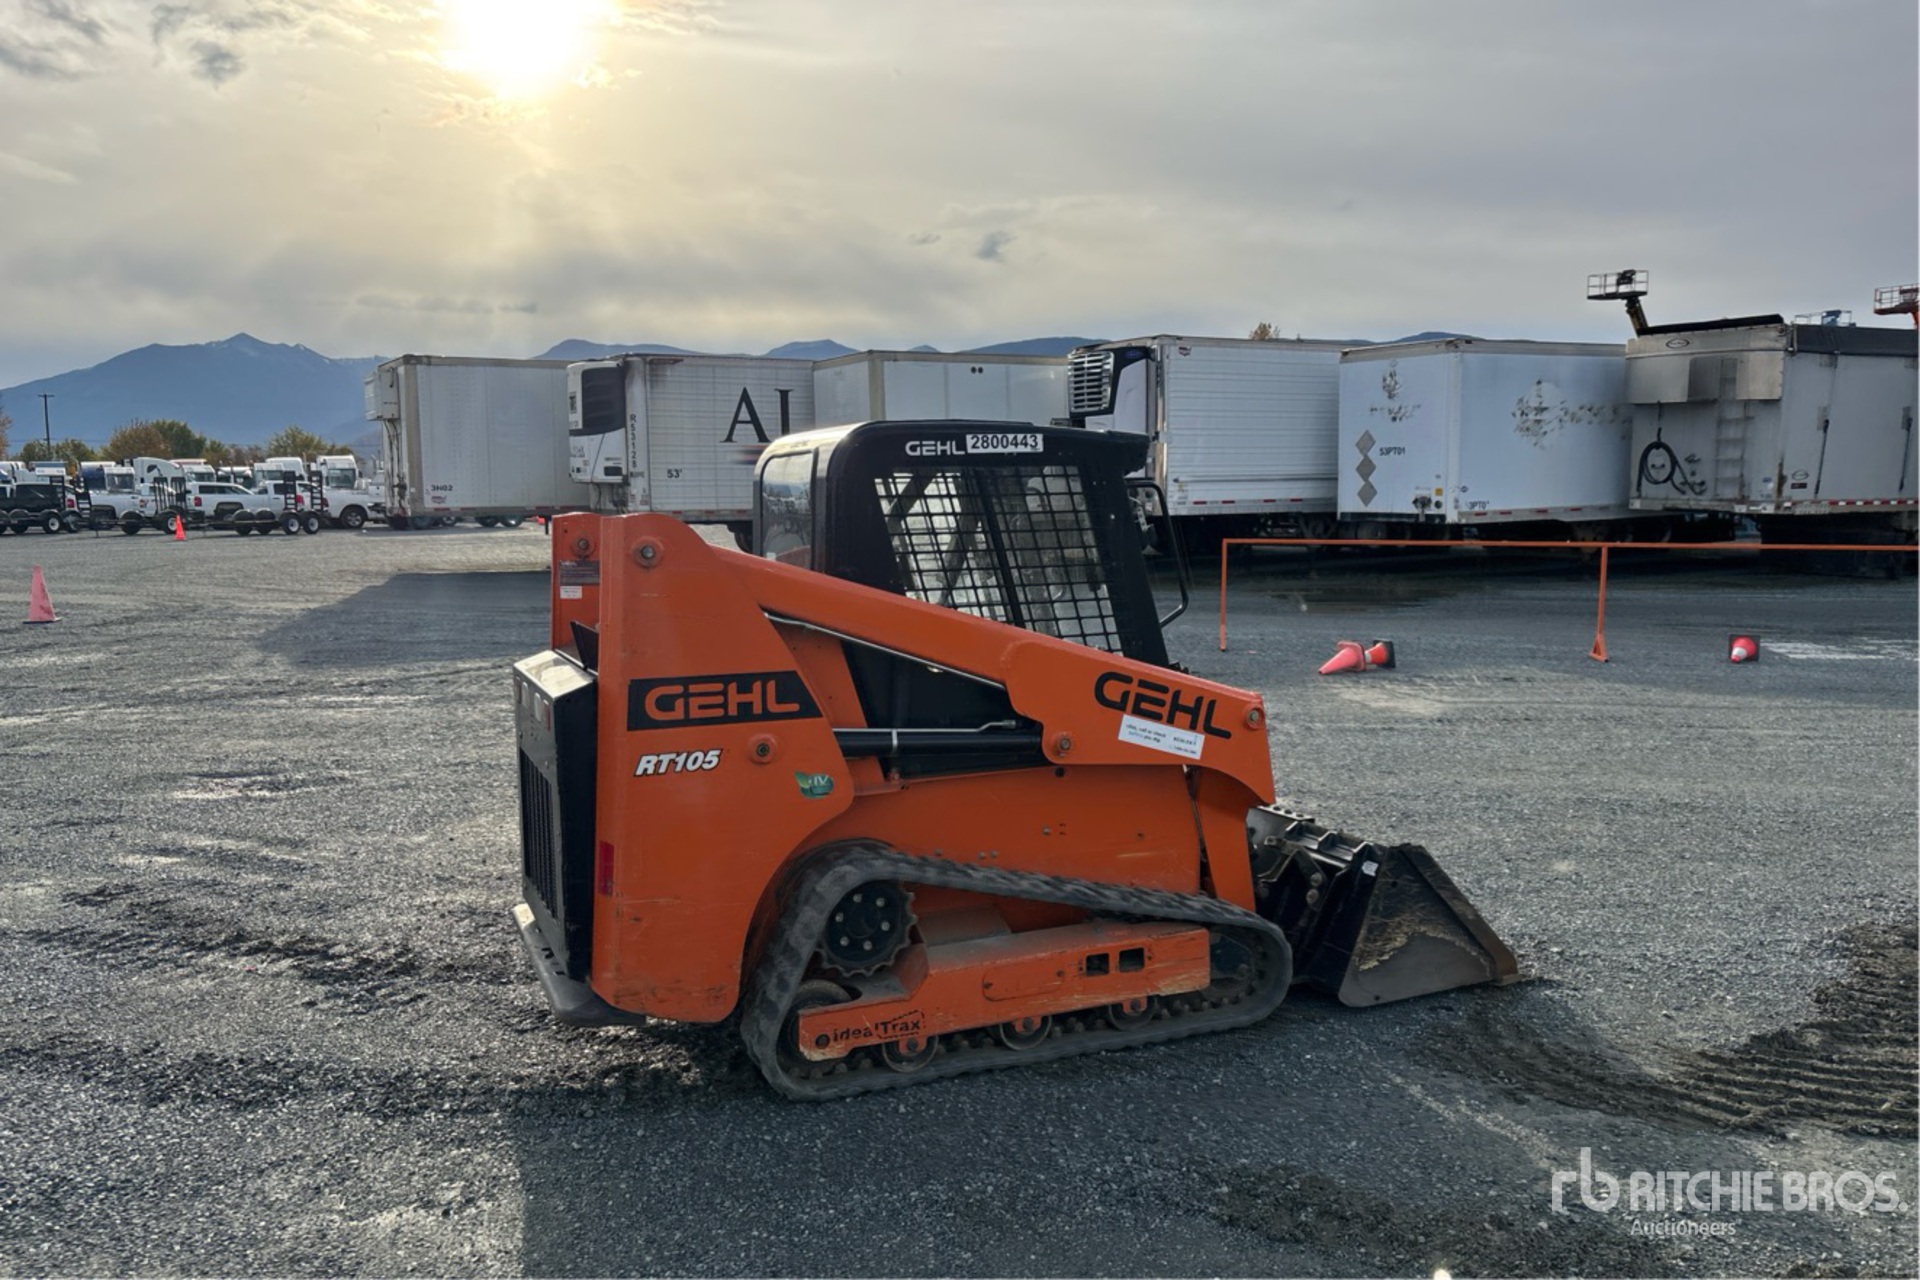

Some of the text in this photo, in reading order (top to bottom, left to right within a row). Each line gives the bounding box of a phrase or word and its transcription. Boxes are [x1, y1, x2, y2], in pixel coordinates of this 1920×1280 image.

[905, 440, 966, 456] GEHL
[970, 434, 1038, 449] 2800443
[644, 680, 801, 721] GEHL
[1094, 671, 1232, 739] GEHL
[634, 749, 723, 777] RT105
